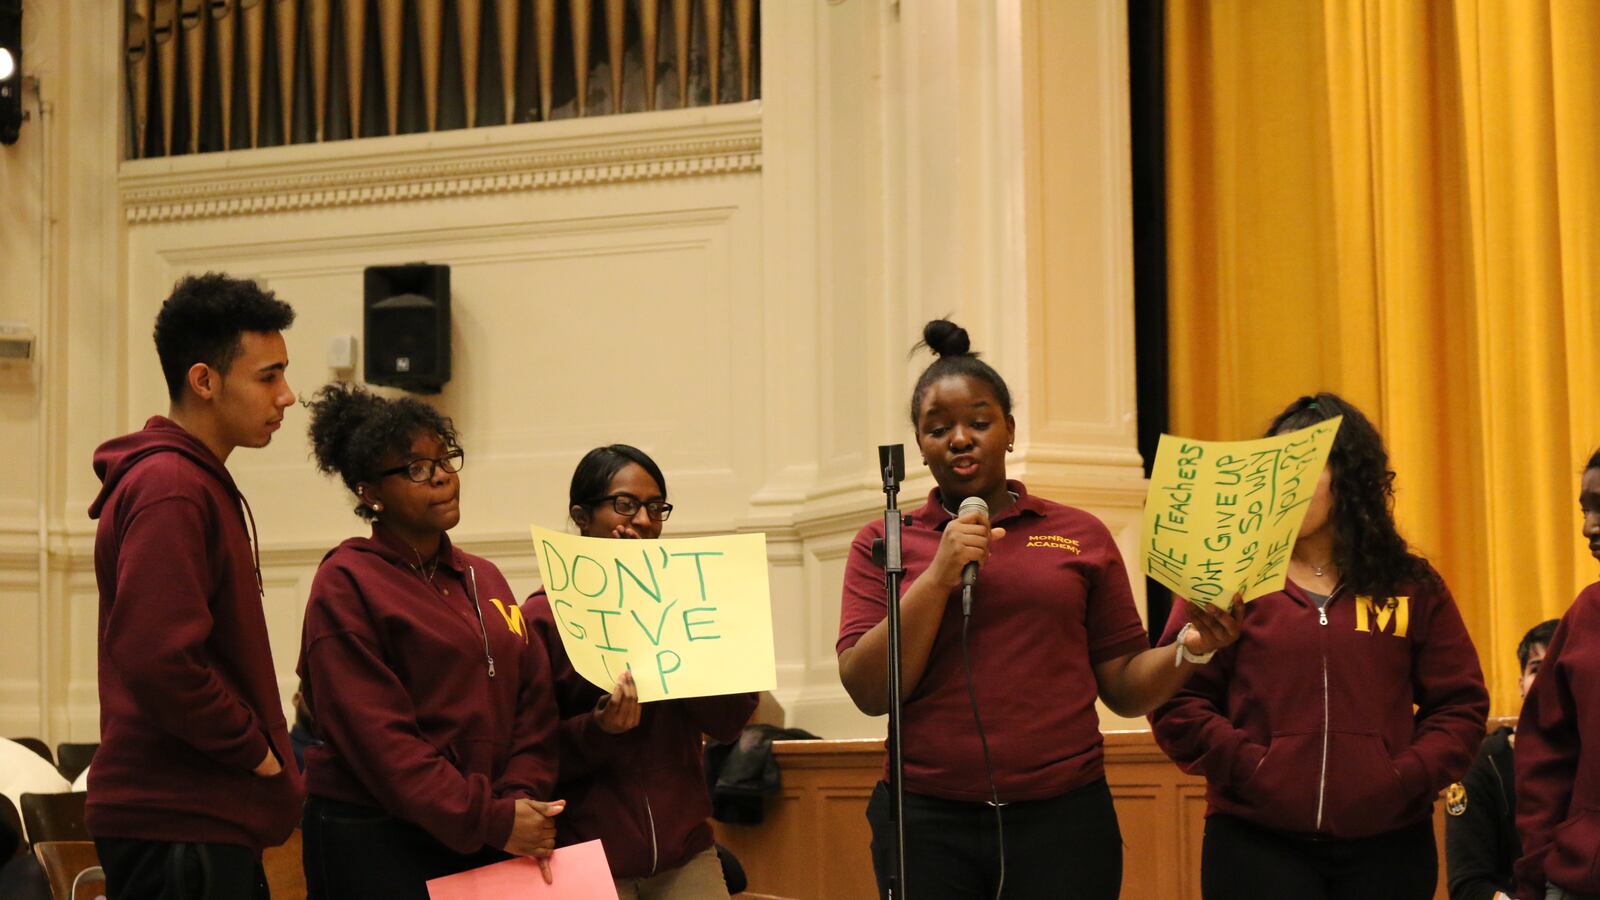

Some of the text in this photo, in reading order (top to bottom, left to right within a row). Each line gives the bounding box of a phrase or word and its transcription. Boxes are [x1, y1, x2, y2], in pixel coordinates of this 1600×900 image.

[1215, 455, 1248, 486] UP
[1204, 492, 1238, 551] GIVE
[1238, 500, 1263, 535] SO
[1026, 541, 1081, 555] ACADEMY
[1028, 535, 1080, 547] MONROE
[1148, 538, 1187, 587] THE
[1234, 541, 1259, 574] US
[1254, 528, 1293, 587] ARE
[542, 539, 724, 608] DON'T
[554, 599, 721, 653] GIVE
[1354, 595, 1410, 638] M
